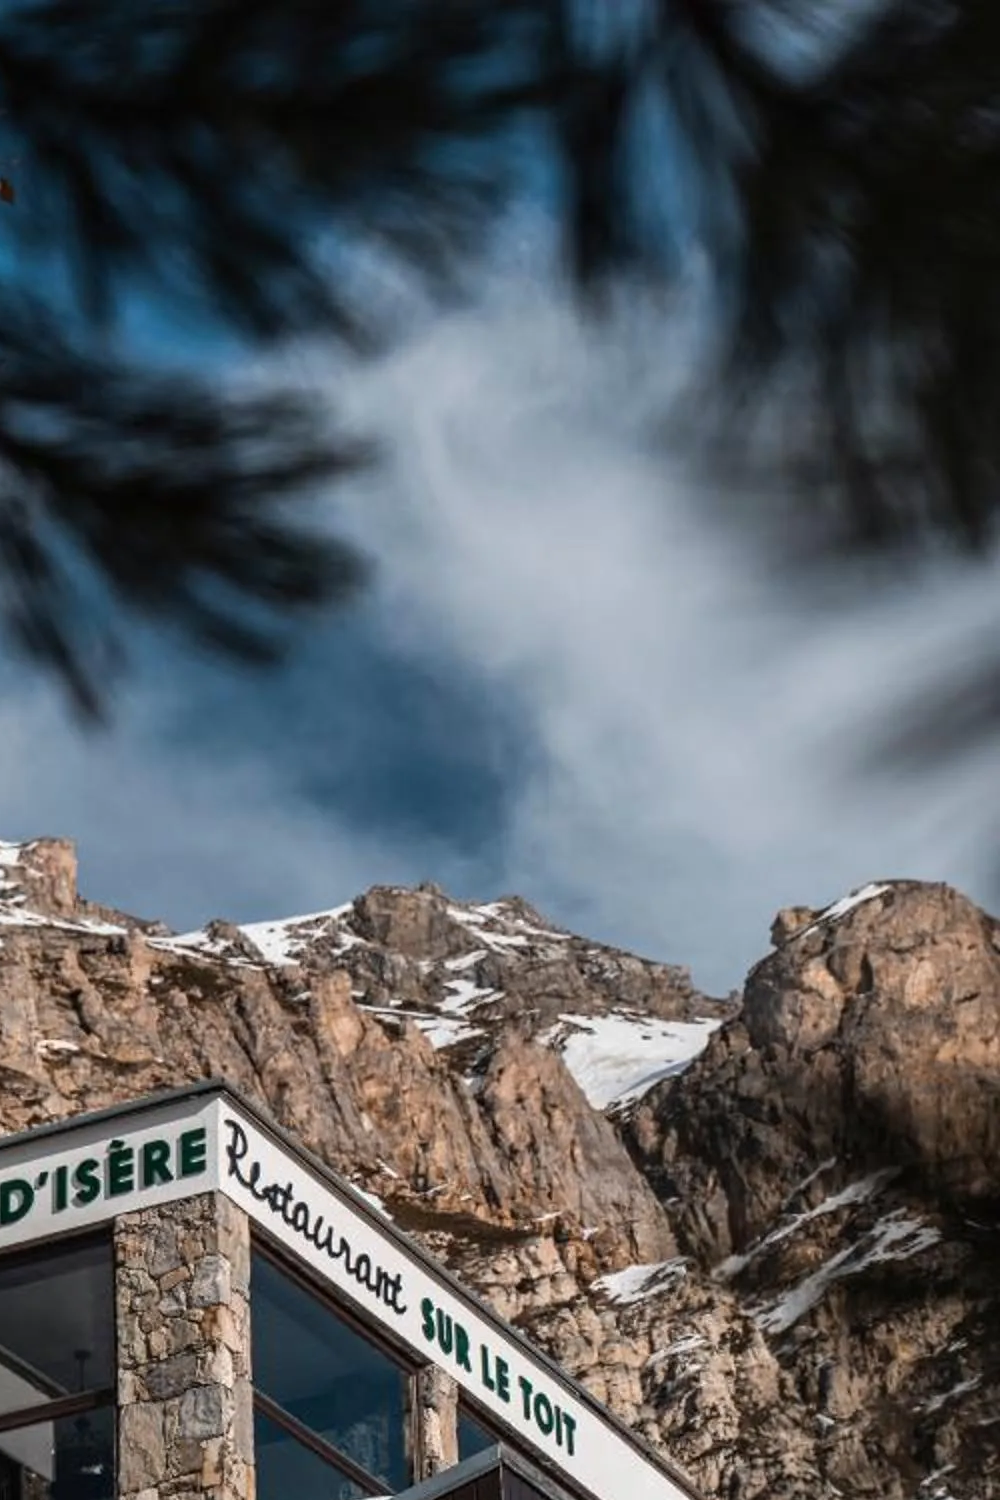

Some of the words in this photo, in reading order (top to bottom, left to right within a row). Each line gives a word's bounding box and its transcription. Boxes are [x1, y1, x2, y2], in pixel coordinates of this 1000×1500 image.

[224, 1119, 408, 1315] Restaurant
[420, 1297, 472, 1374] SUR
[480, 1344, 511, 1403] LE
[519, 1376, 578, 1457] TOIT
